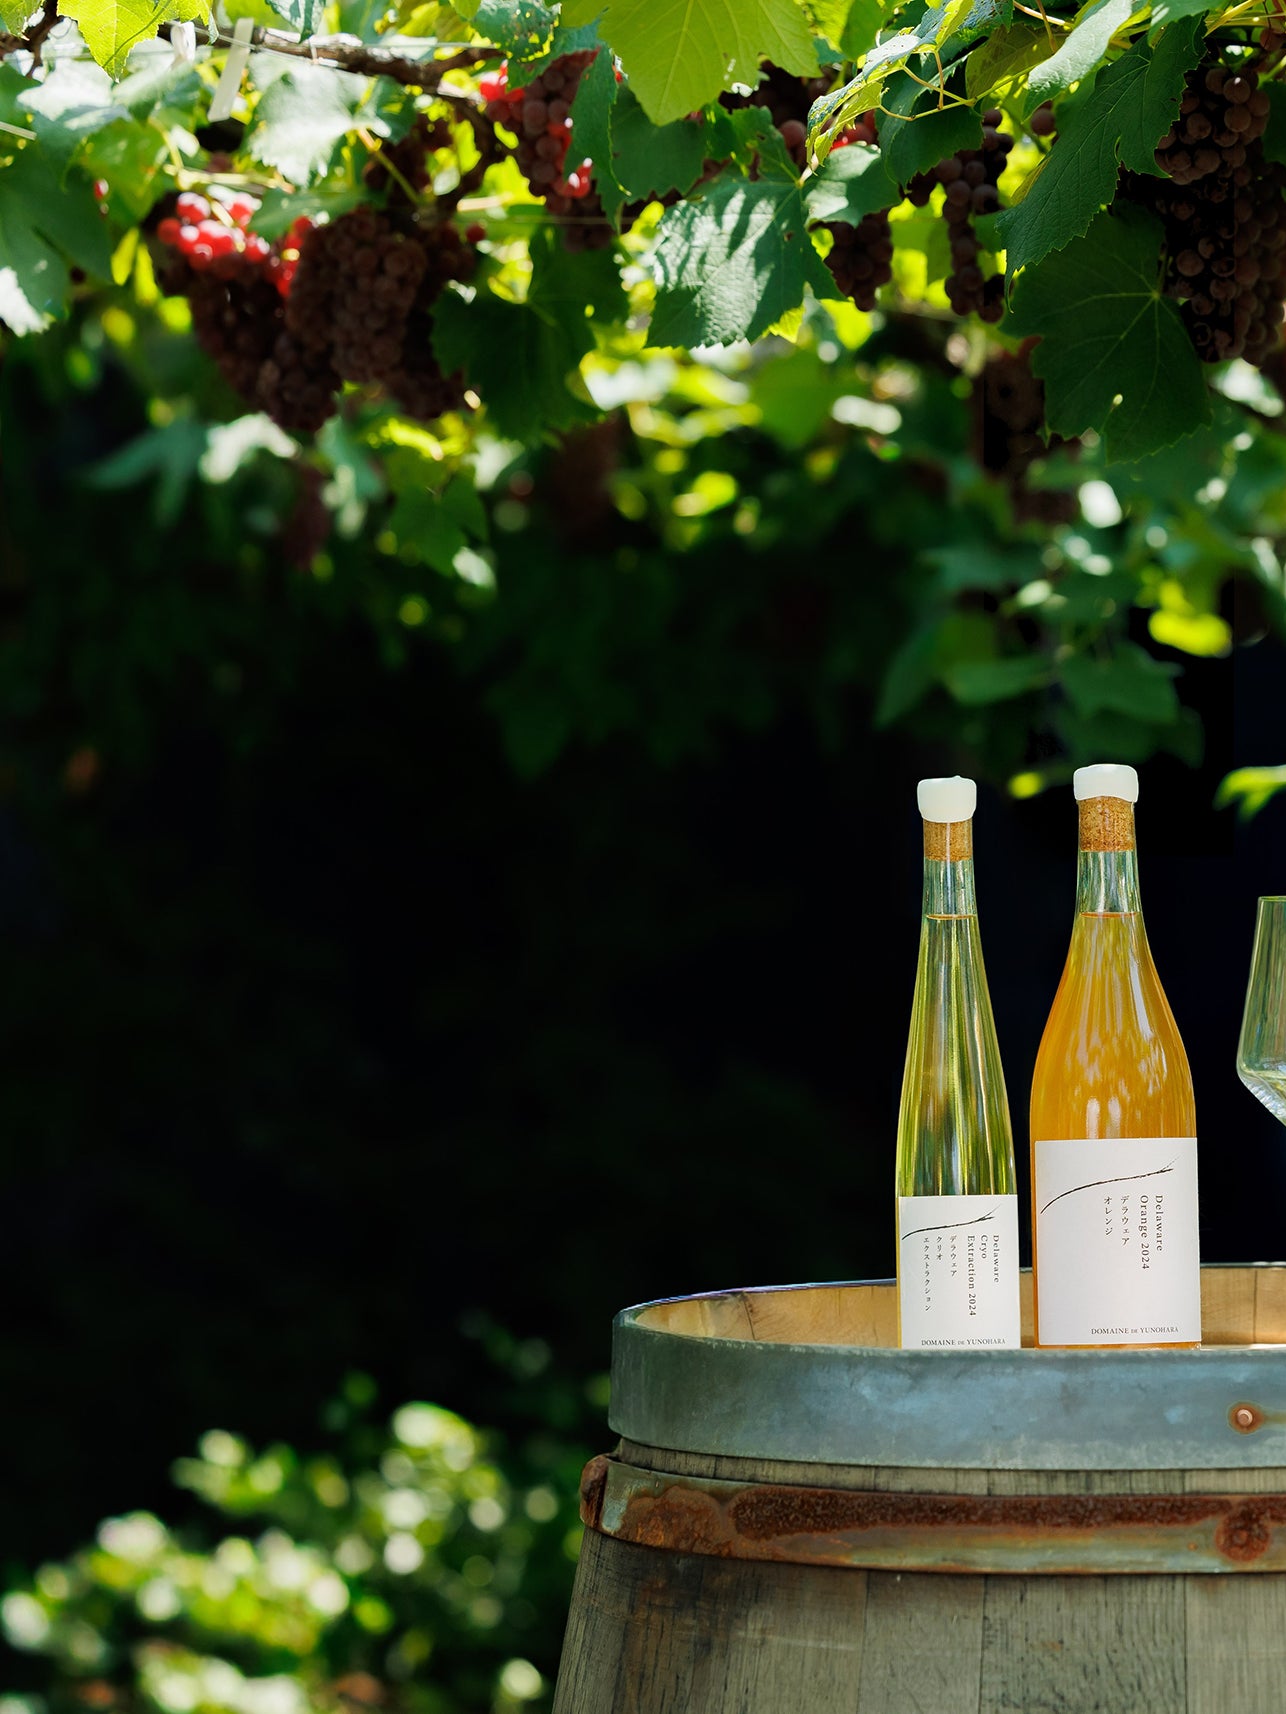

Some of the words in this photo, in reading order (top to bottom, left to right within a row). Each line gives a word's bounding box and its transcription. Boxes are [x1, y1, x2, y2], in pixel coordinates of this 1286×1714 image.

[1103, 1196, 1113, 1236] オレンジ
[1121, 1195, 1130, 1246] デラウェア
[1138, 1195, 1149, 1238] Orange
[1155, 1195, 1164, 1251] Delaware
[967, 1235, 977, 1289] Extraction
[979, 1235, 989, 1259] Cryo
[1141, 1243, 1150, 1269] 2024
[968, 1293, 977, 1316] 2024
[966, 1338, 1006, 1346] YUNOHARA
[1091, 1327, 1129, 1335] DOMAINE
[1140, 1326, 1179, 1334] YUNOHARA
